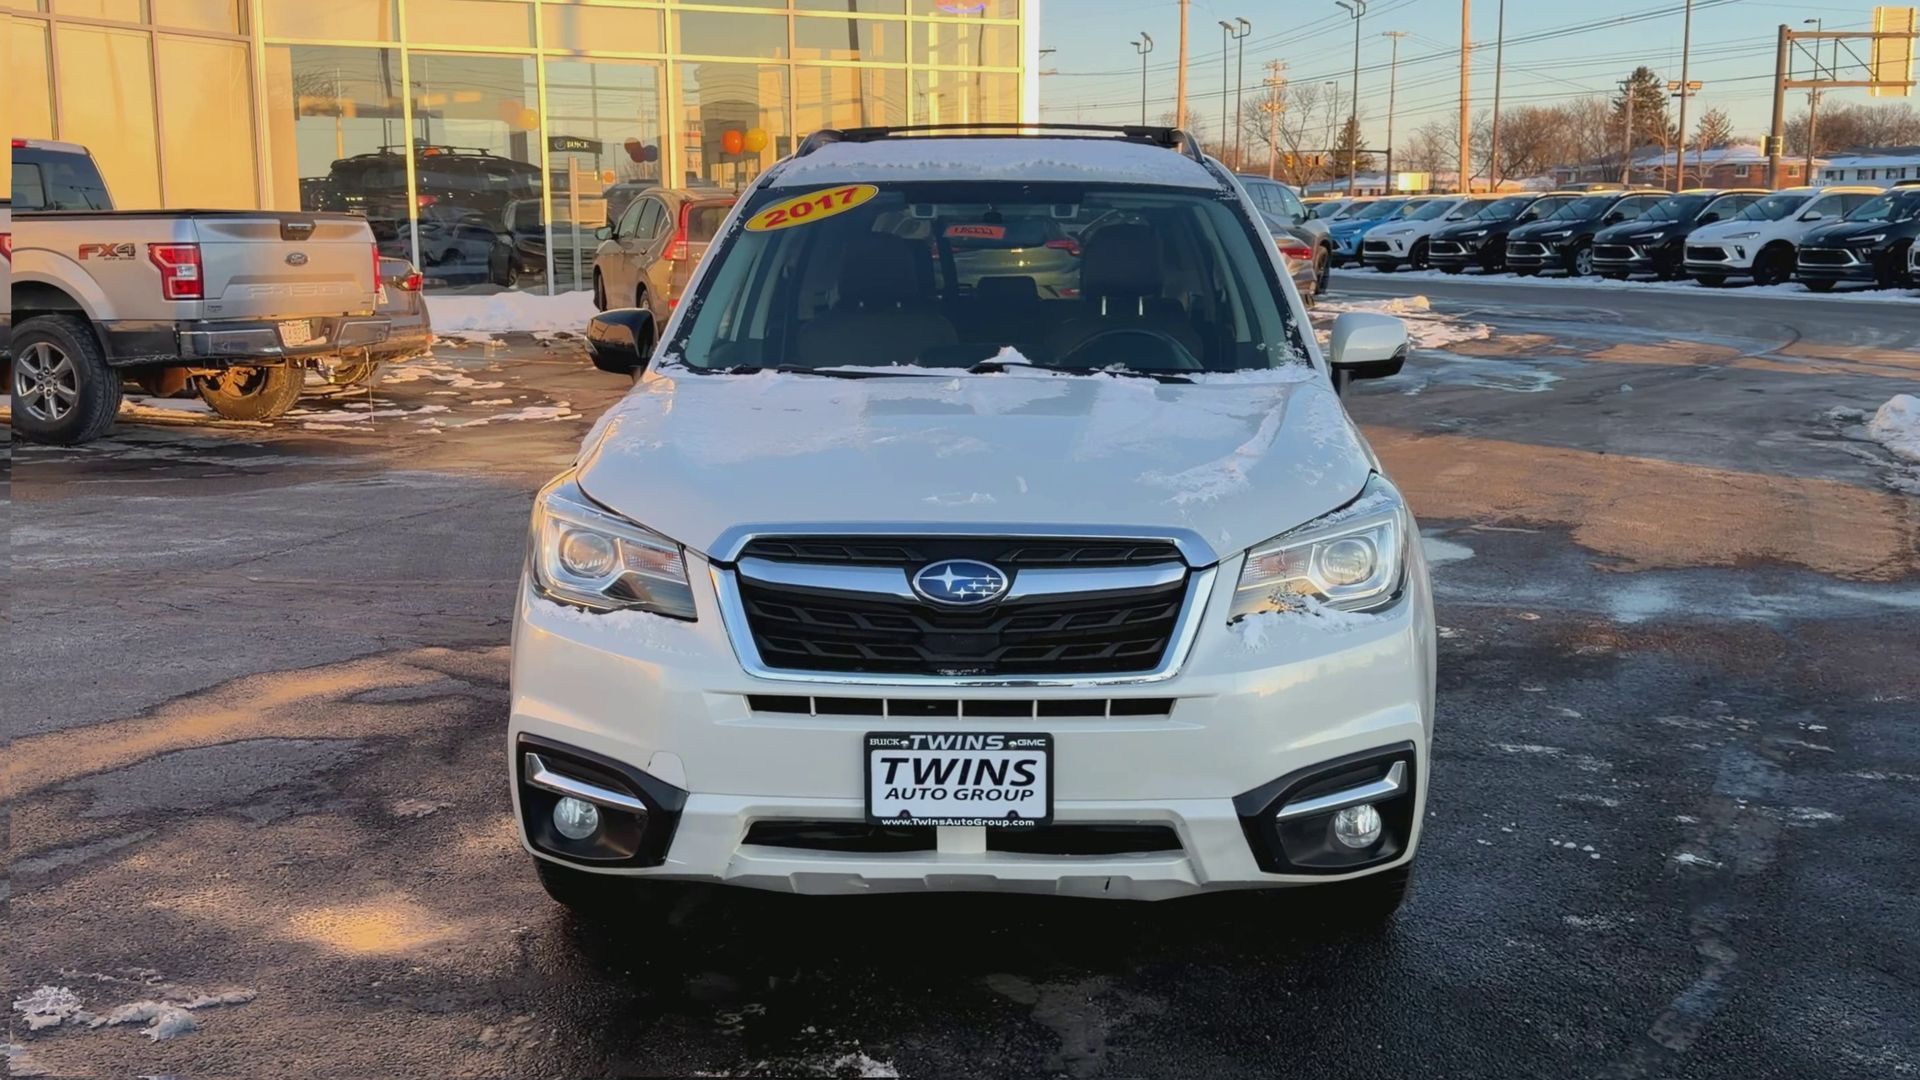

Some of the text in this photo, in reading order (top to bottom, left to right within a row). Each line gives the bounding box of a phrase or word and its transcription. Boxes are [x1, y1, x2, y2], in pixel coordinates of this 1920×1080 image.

[763, 186, 859, 229] 2017
[78, 243, 136, 260] FX4
[869, 734, 1046, 750] BUICK TWINS GMC
[880, 757, 1038, 787] TWINS
[884, 787, 1034, 801] AUTO GROUP
[881, 818, 1035, 827] www.TwinsAutoGroup.com
